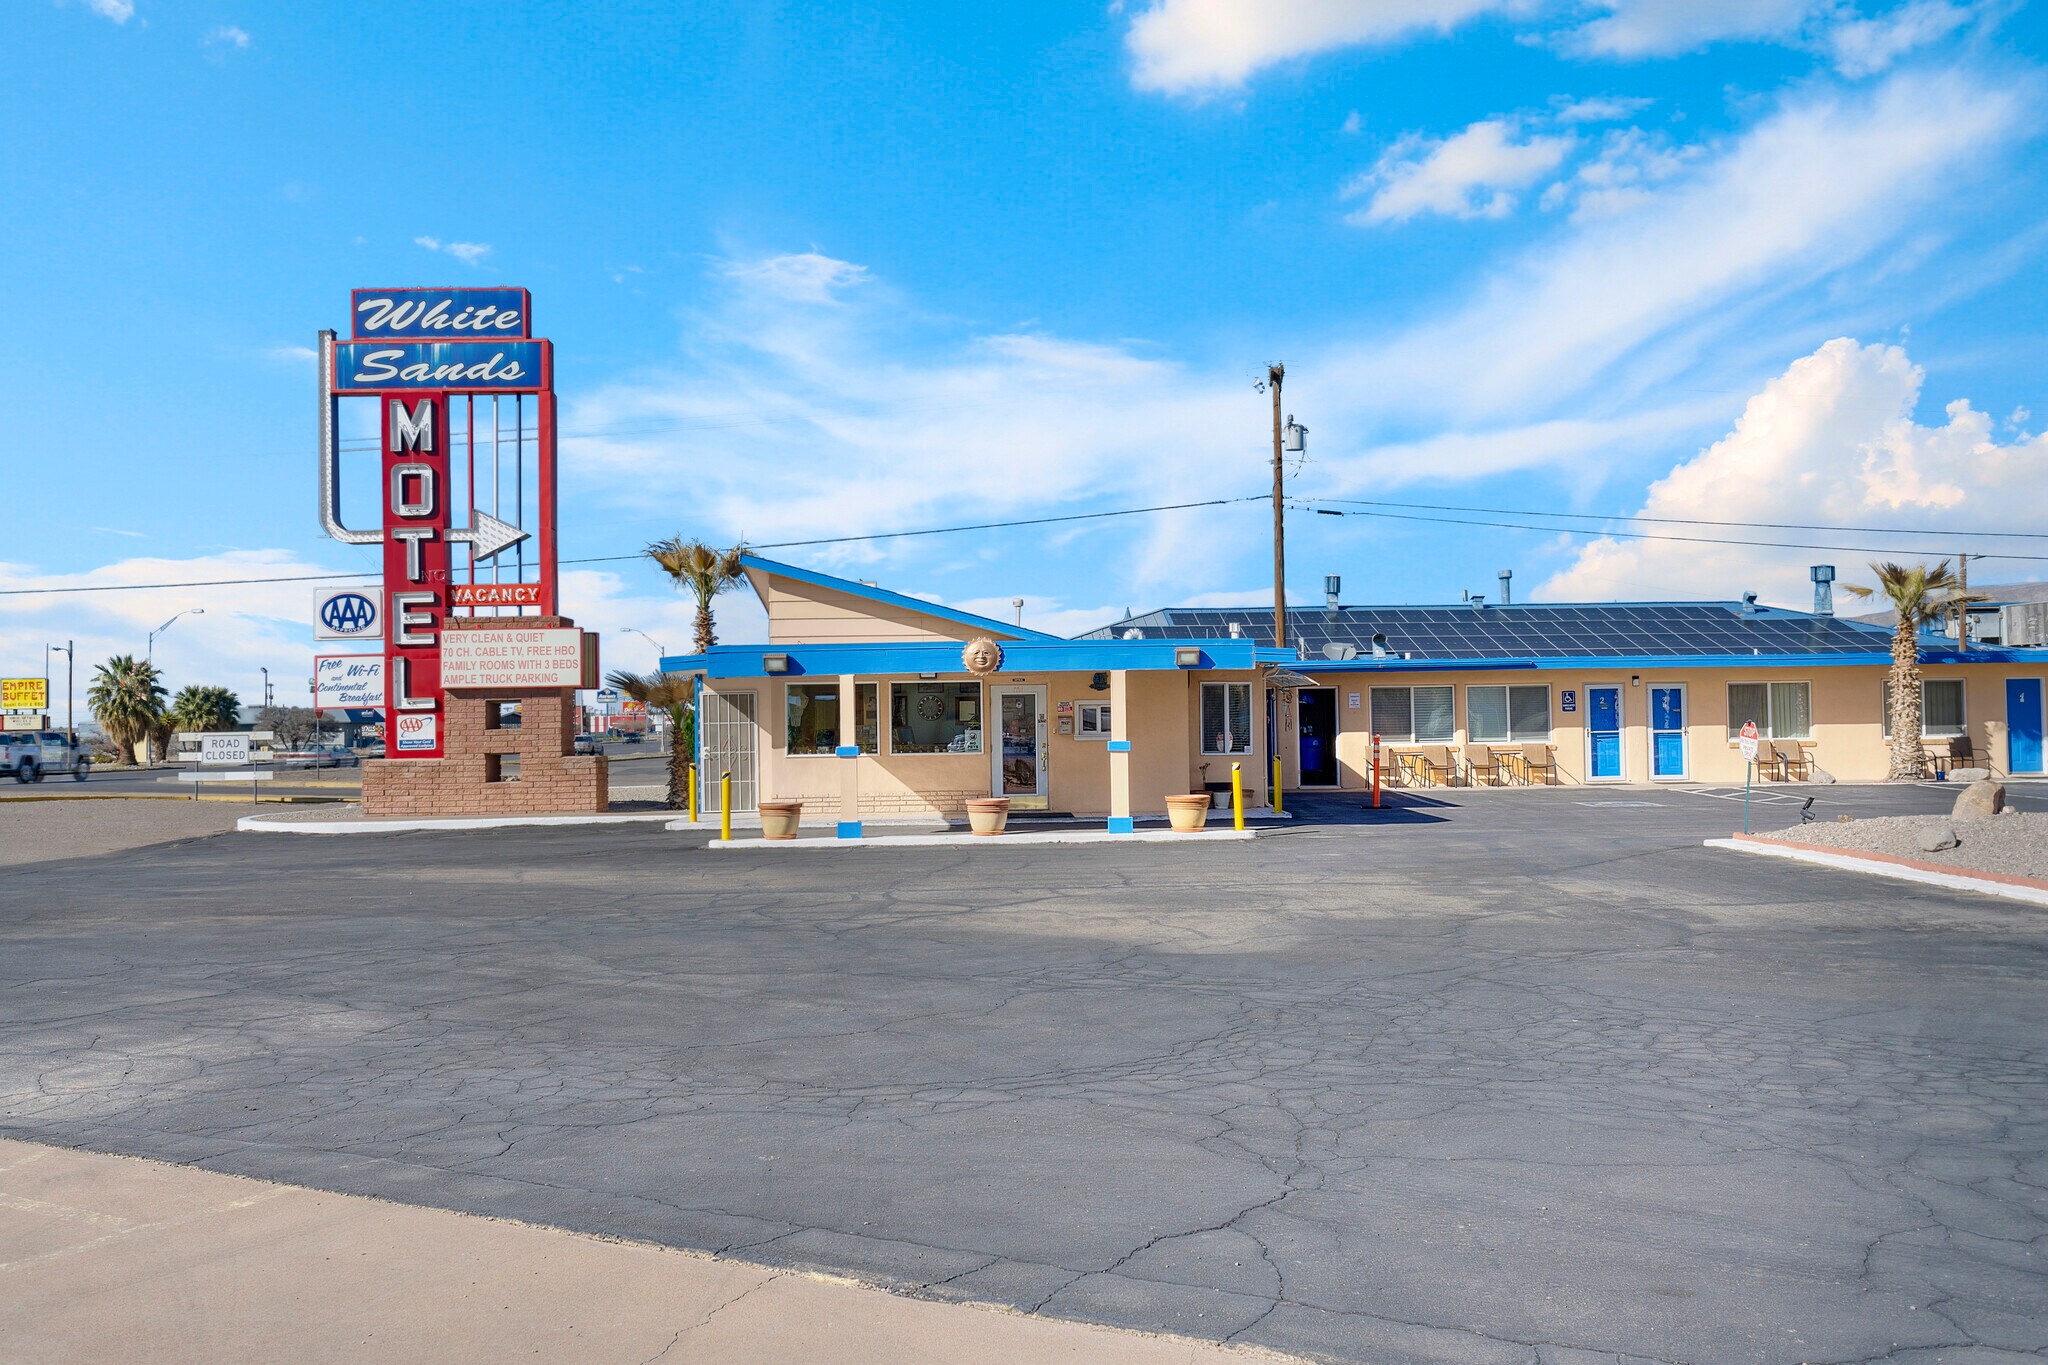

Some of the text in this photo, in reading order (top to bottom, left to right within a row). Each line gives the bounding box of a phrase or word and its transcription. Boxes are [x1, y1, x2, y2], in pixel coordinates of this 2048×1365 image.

[357, 298, 521, 331] White
[354, 349, 526, 382] Sands
[390, 398, 435, 709] MOTEL
[451, 587, 539, 603] VACANCY
[327, 594, 370, 629] AAA
[443, 632, 544, 644] VERY CLEAN & QUIET
[443, 645, 576, 657] 70 CH. CABLE TV, FREE HBO
[318, 659, 343, 672] Free
[347, 664, 381, 677] Wi-Fi
[443, 659, 579, 671] FAMILY ROOMS WITH 3 BEDS
[443, 672, 558, 684] AMPLE TRUCK PARKING
[2, 681, 43, 690] EMPIRE
[317, 682, 368, 692] Continental
[2, 692, 45, 701] BUFFET
[339, 692, 383, 706] Breakfast
[1743, 726, 1756, 738] STOP
[211, 739, 240, 748] ROAD
[205, 750, 246, 760] CLOSED
